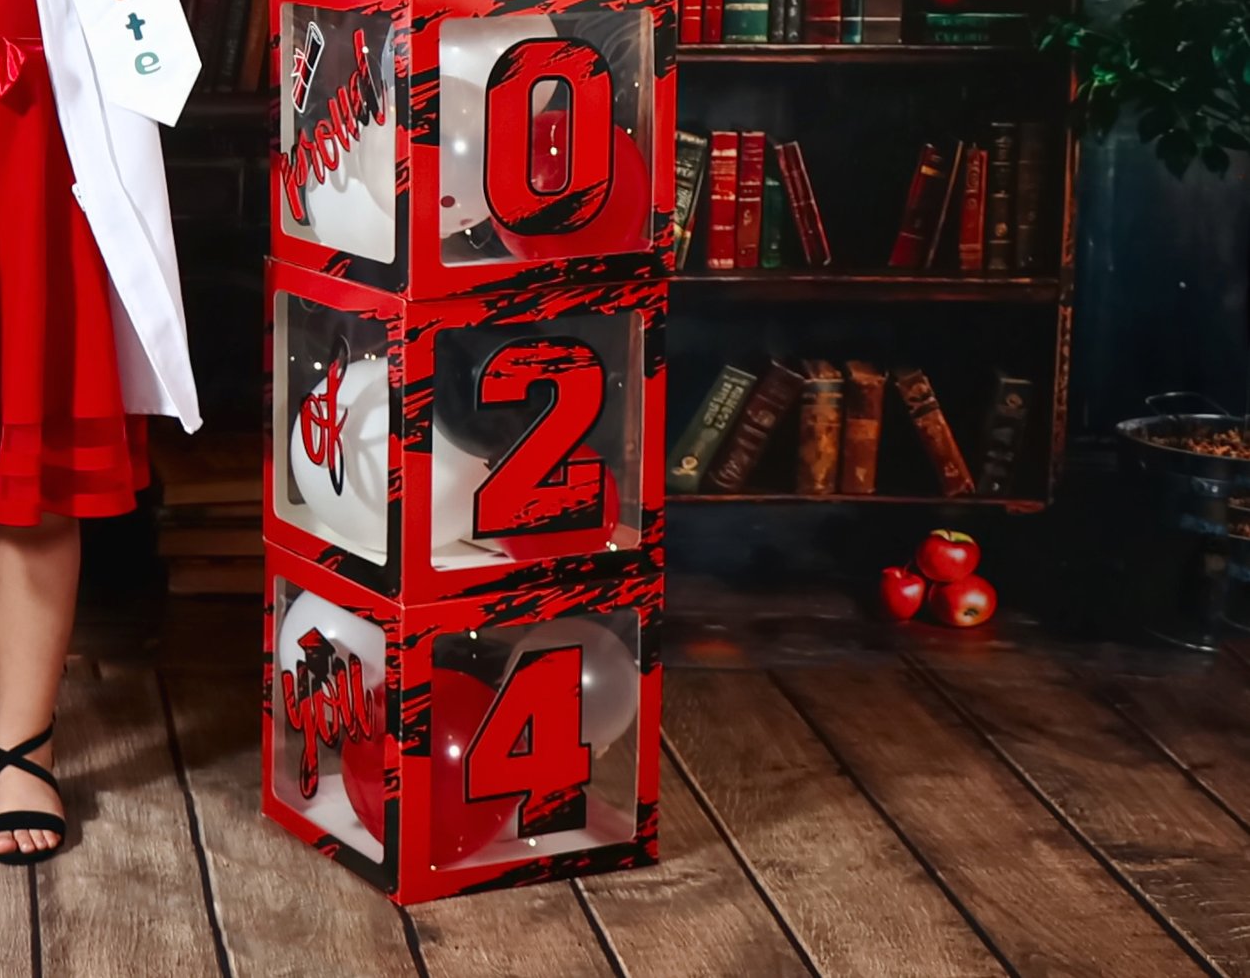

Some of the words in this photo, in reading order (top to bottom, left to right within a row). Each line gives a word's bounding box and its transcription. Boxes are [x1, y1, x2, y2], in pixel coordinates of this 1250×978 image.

[280, 28, 386, 222] proud
[483, 36, 615, 236] 0
[299, 335, 349, 497] of
[472, 335, 605, 540] 2
[281, 653, 374, 799] you
[461, 643, 592, 839] 4
